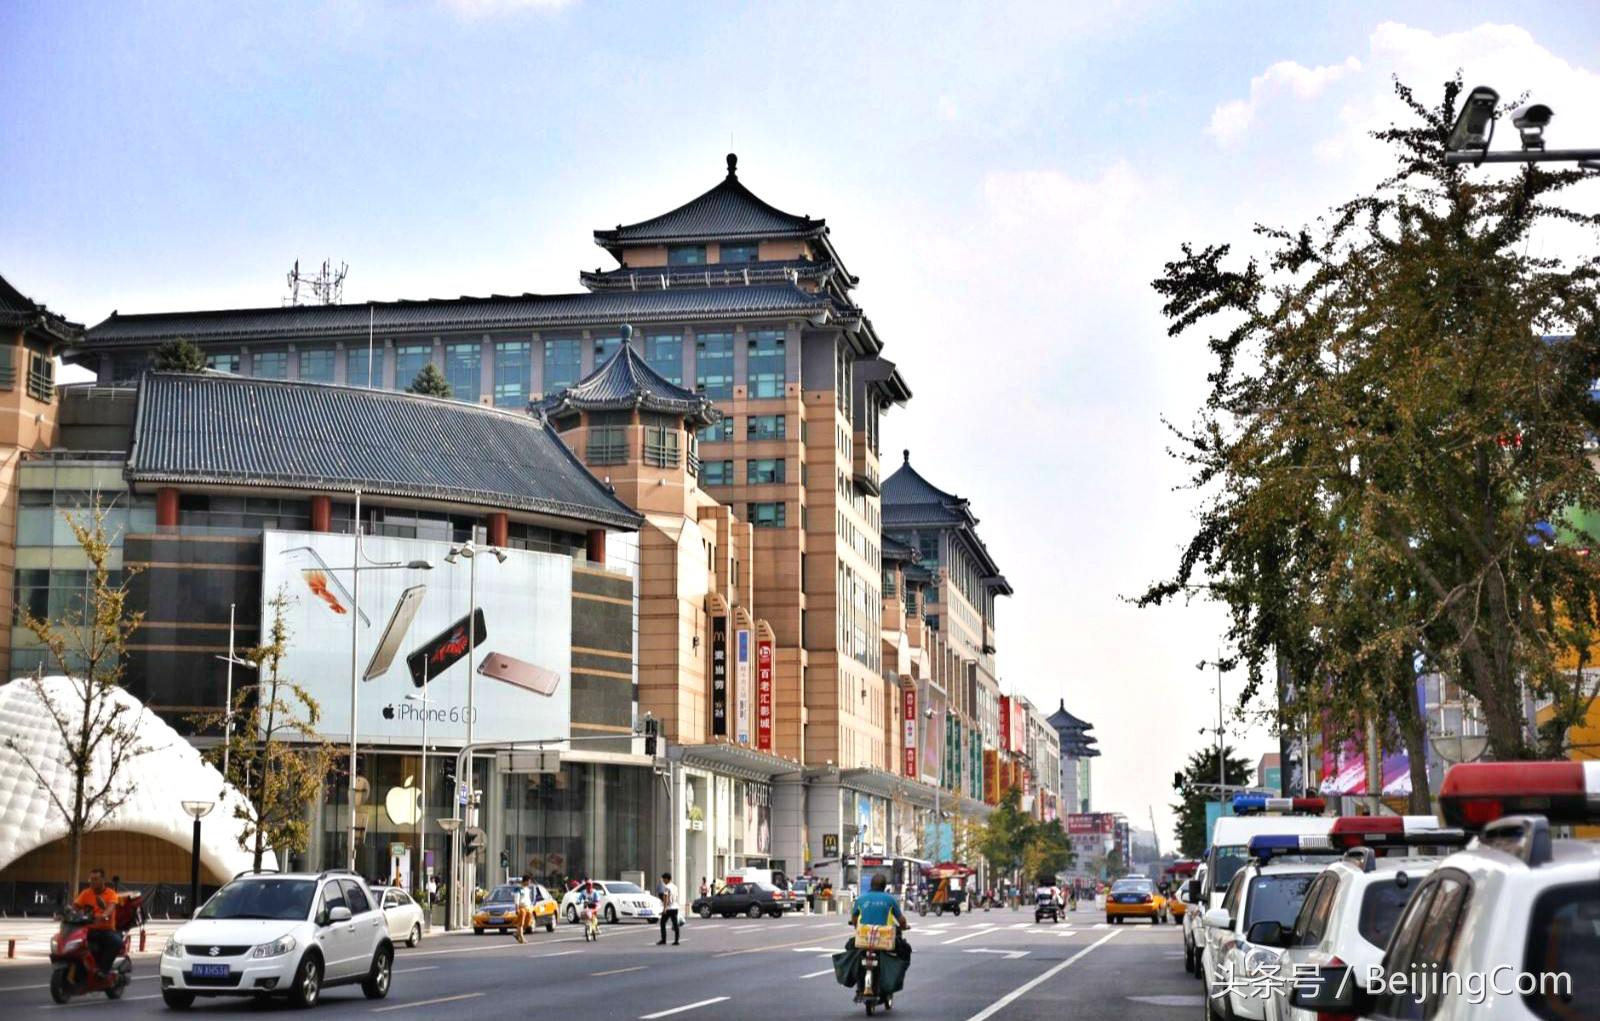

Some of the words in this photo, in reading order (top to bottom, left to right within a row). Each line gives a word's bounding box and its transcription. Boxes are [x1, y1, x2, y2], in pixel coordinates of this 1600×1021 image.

[397, 703, 446, 722] iPhone
[449, 706, 459, 723] 6
[760, 669, 770, 728] 百老汇影城
